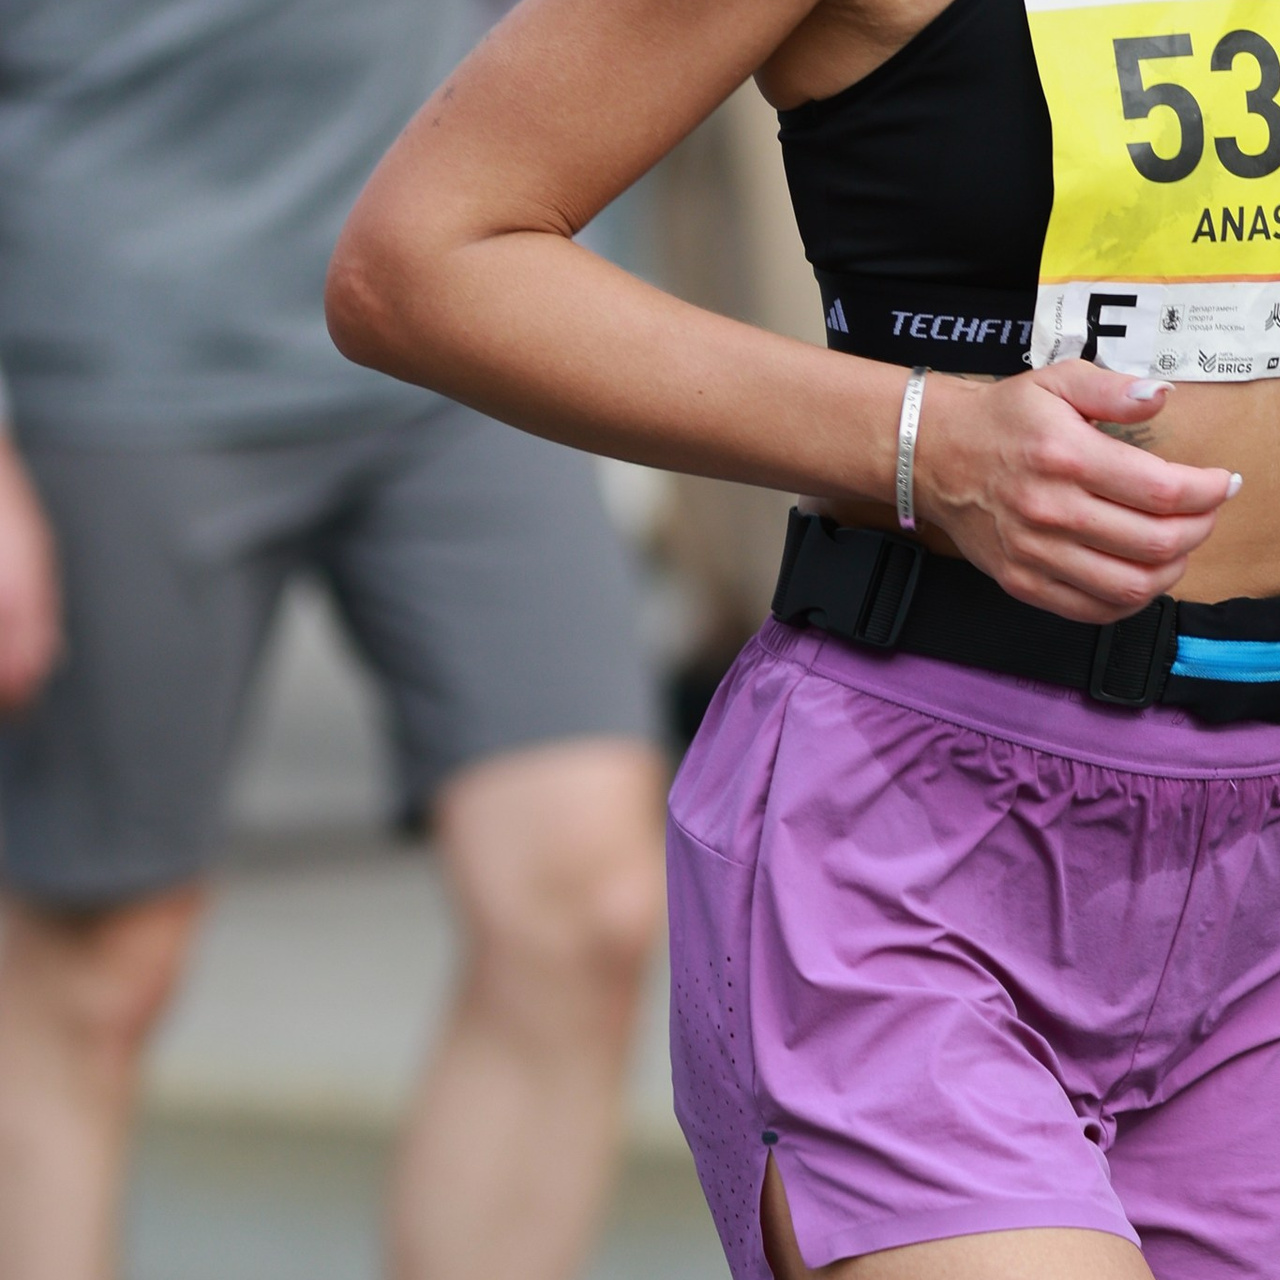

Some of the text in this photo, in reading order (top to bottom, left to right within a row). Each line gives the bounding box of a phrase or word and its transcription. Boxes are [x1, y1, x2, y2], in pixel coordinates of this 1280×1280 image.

[891, 310, 1033, 345] TECHFIT
[1080, 293, 1138, 362] F
[1217, 362, 1253, 374] BRICS
